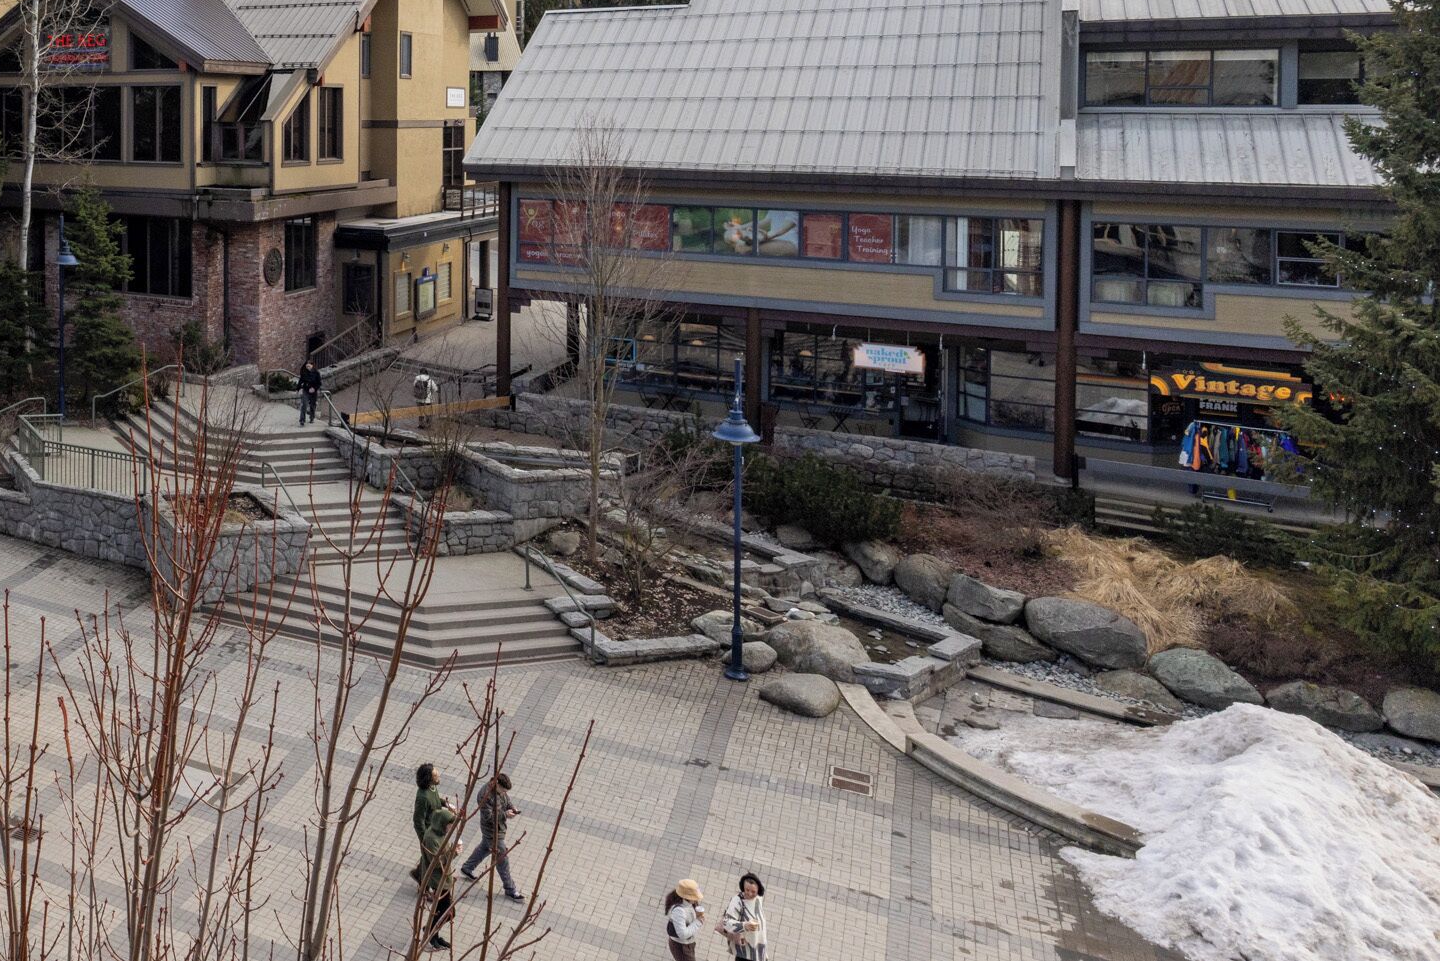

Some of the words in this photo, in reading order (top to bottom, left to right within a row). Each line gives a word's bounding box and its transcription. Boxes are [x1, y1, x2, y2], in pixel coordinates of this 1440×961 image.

[48, 34, 73, 47] THE
[78, 33, 107, 47] KEG
[851, 226, 871, 234] Yoga
[853, 235, 883, 243] Teacher
[857, 245, 888, 255] Training
[1171, 373, 1292, 401] Vintage
[1199, 401, 1238, 413] FRANK
